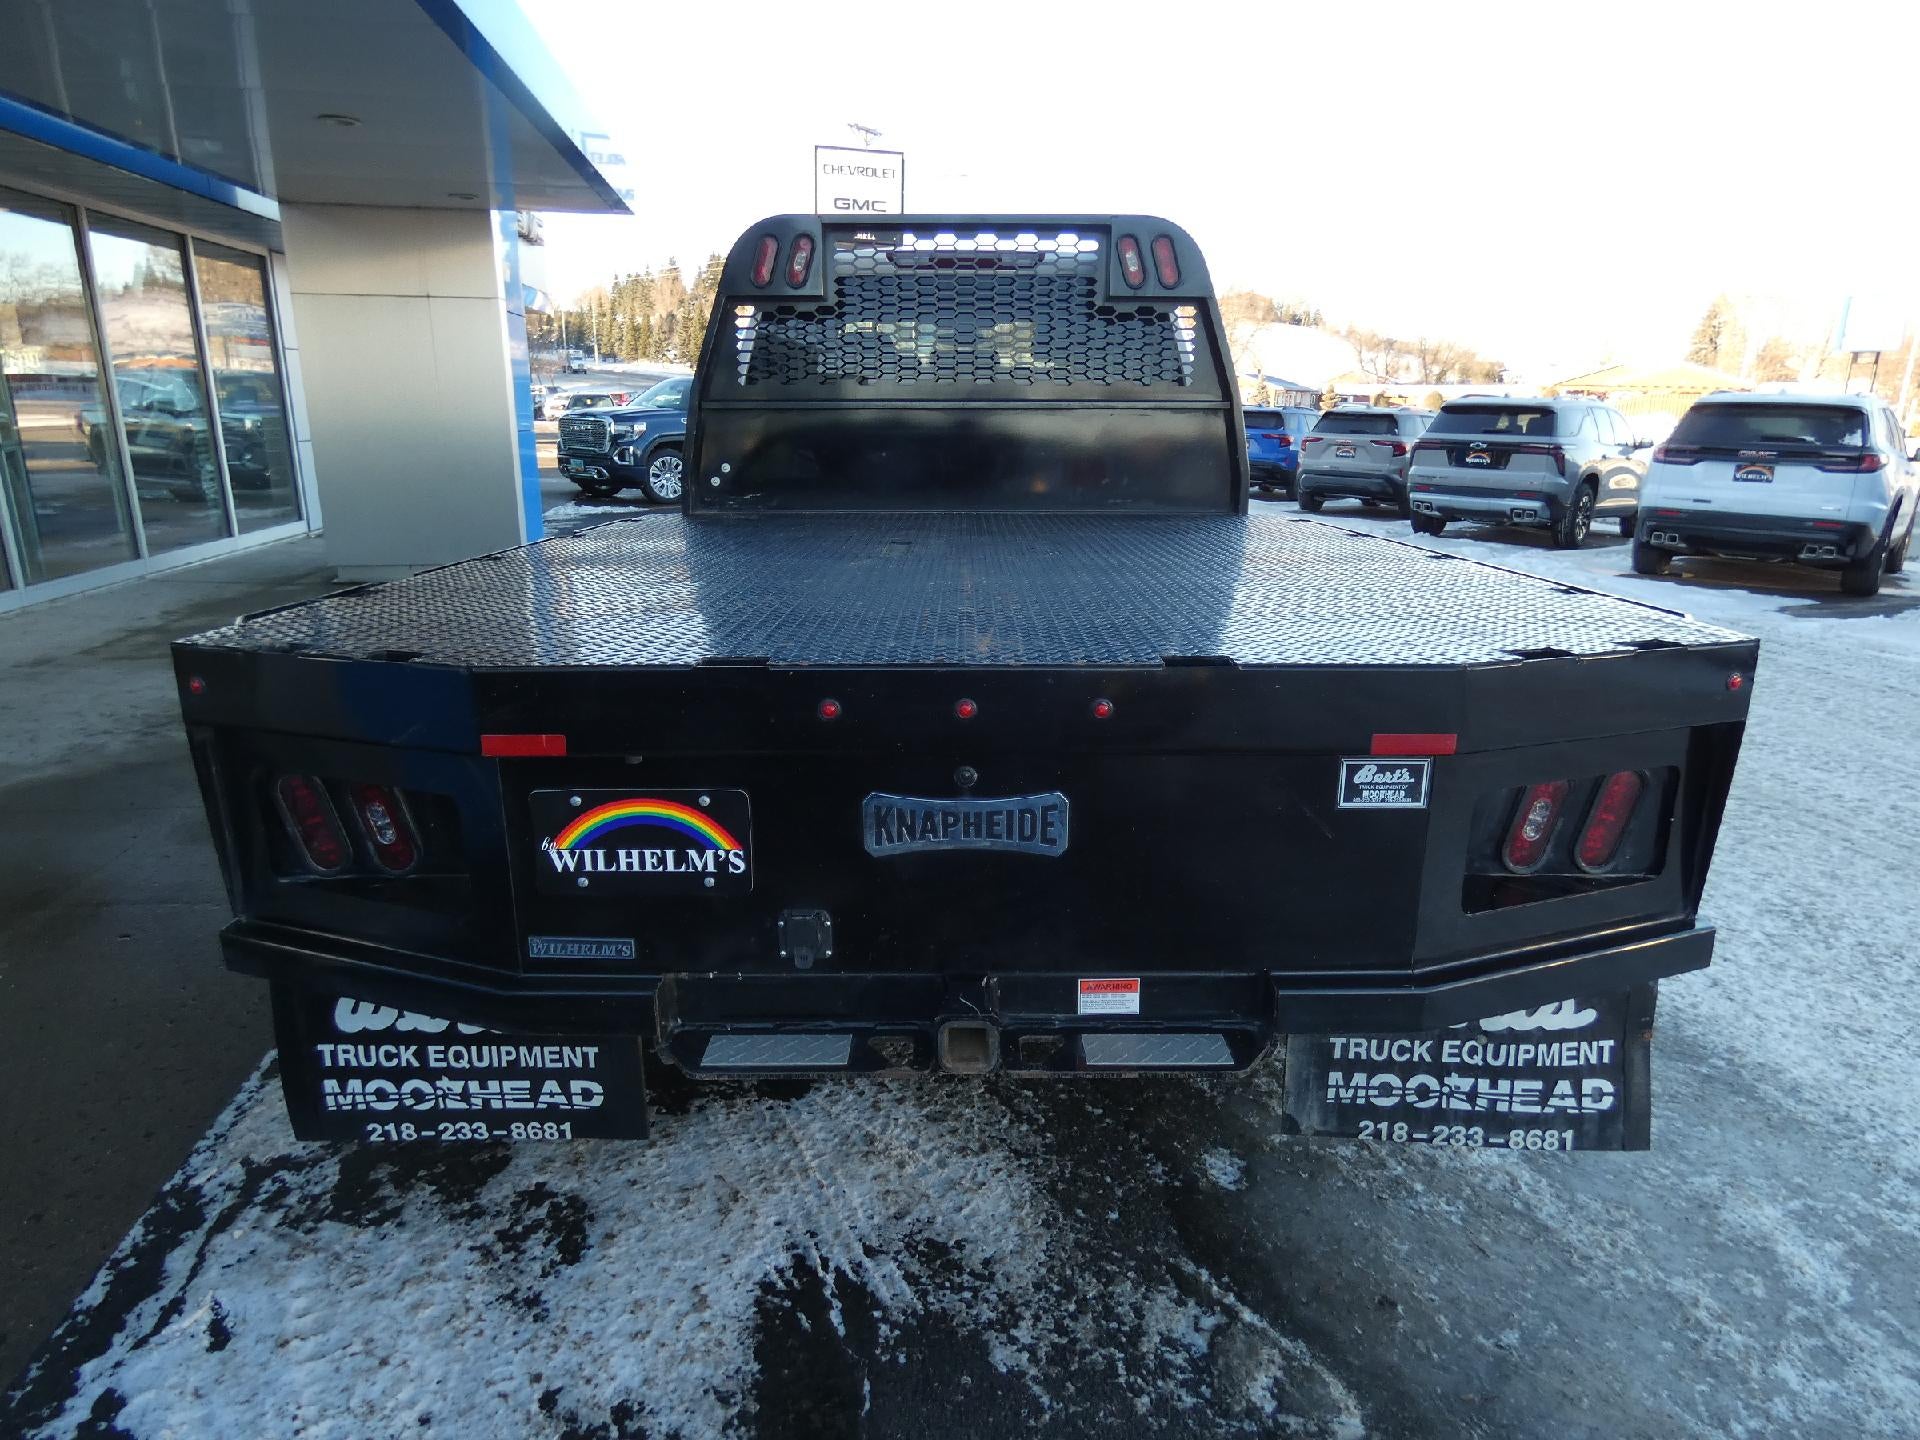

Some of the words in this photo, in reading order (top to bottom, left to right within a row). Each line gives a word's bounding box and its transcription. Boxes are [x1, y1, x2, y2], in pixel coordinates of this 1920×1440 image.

[823, 163, 897, 179] CHEVROLET
[834, 197, 887, 213] GMC
[873, 803, 1059, 847] KNAPHEIDE
[541, 836, 559, 853] by
[549, 848, 747, 874] WILHELM'S
[532, 943, 632, 957] WILHELM'S
[317, 1043, 420, 1069] TRUCK
[428, 1045, 600, 1070] EQUIPMENT
[1329, 1037, 1433, 1064] TRUCK
[1441, 1039, 1616, 1067] EQUIPMENT
[322, 1075, 605, 1112] MOORHEAD
[1326, 1072, 1616, 1114] MOORHEAD
[366, 1121, 574, 1142] 218-233-8681
[1357, 1119, 1575, 1152] 218-233-8681
